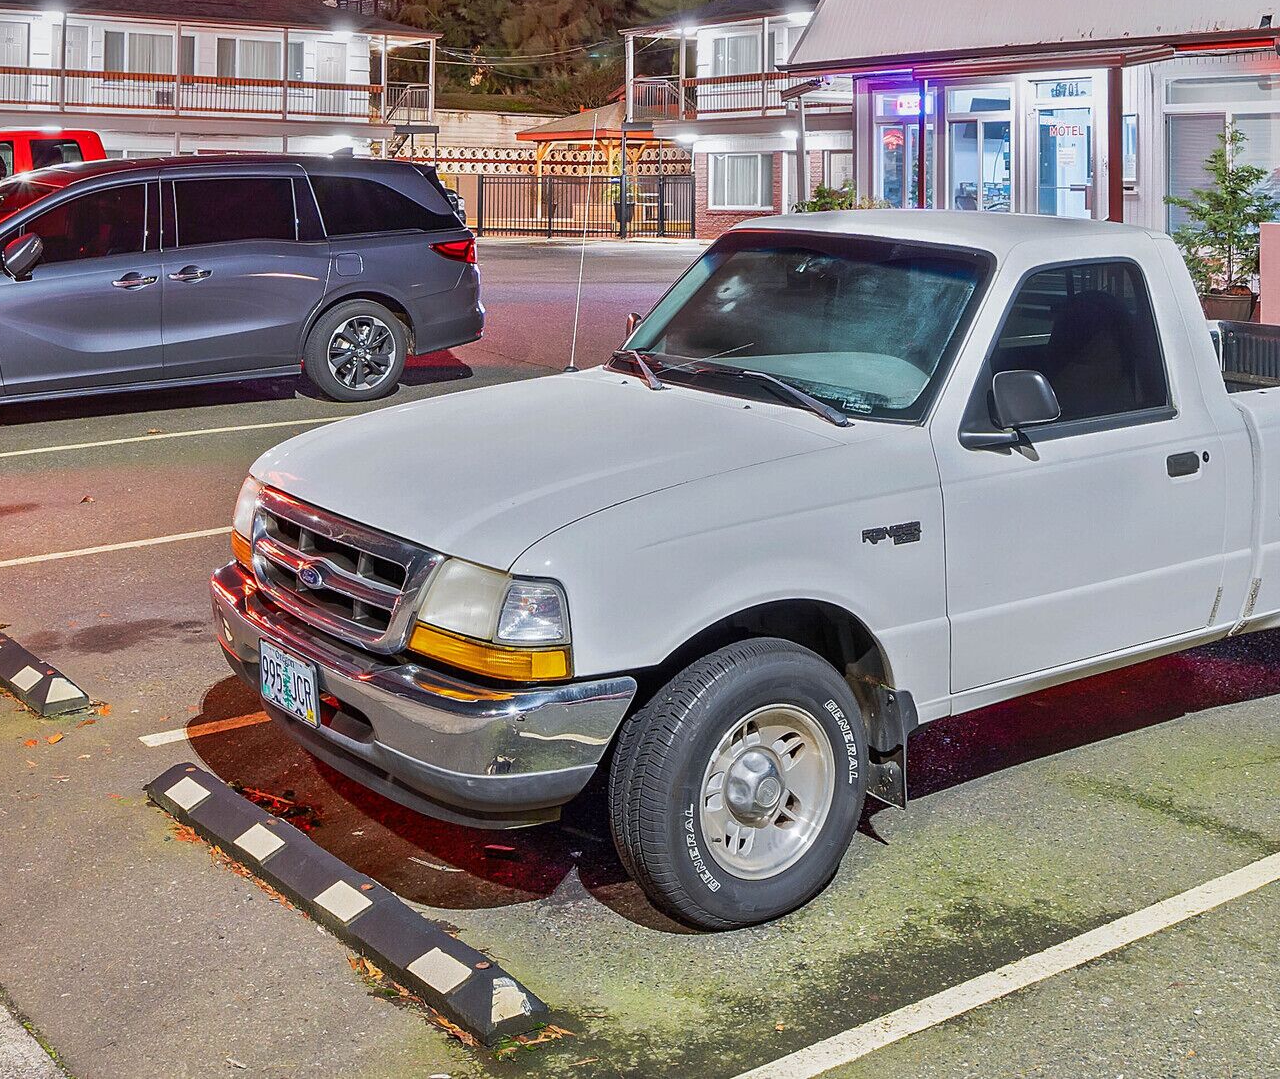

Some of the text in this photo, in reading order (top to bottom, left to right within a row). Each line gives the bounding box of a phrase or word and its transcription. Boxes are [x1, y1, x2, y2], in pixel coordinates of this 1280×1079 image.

[1049, 125, 1084, 136] MOTEL
[262, 654, 313, 711] 995 JCR
[824, 699, 859, 785] GENERAL
[684, 803, 721, 893] GENERAL
